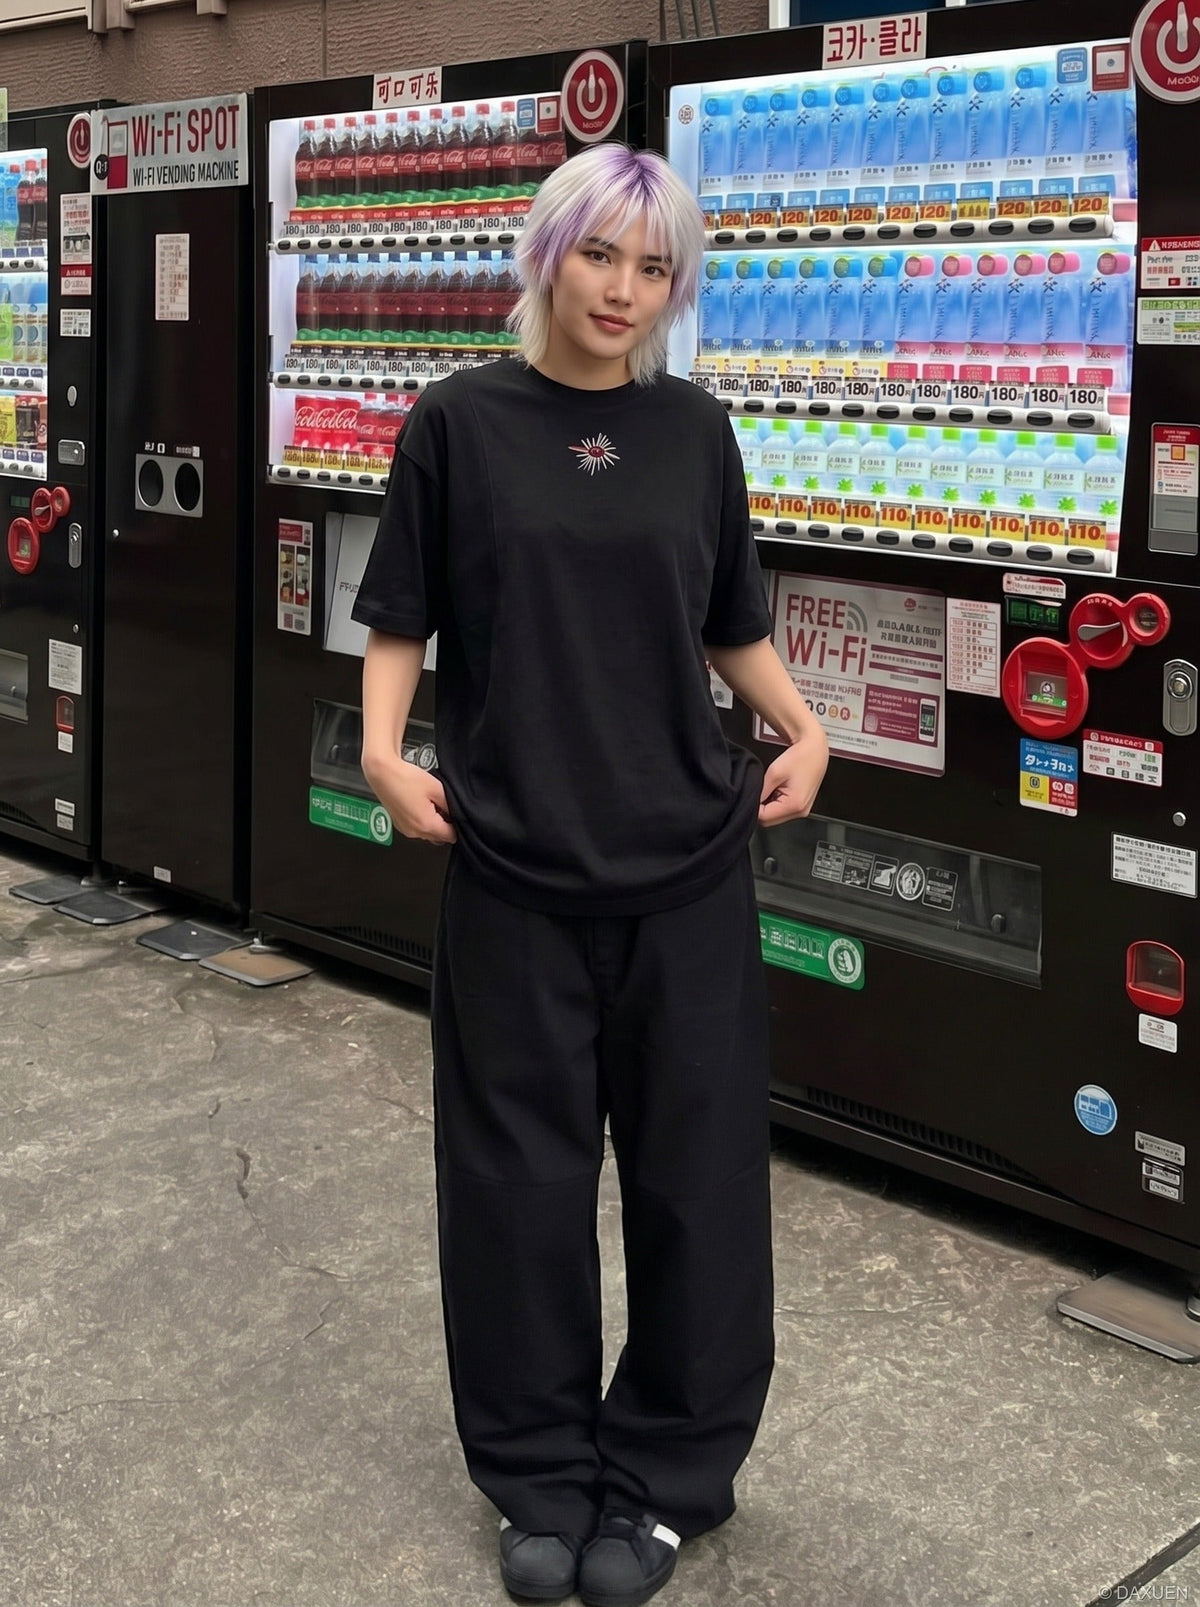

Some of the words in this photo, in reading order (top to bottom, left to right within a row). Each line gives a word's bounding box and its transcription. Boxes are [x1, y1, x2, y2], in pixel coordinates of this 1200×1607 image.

[376, 71, 438, 104] 可口可乐
[132, 111, 181, 157] Wi-Fi
[187, 104, 240, 153] SPOT
[133, 167, 155, 187] WI-FI
[157, 163, 196, 185] VENDING
[998, 202, 1025, 215] 120
[1034, 200, 1062, 214] 120
[1072, 197, 1103, 212] 120
[782, 211, 804, 224] 120
[814, 210, 838, 223] 120
[848, 208, 872, 221] 120
[885, 207, 911, 220] 120
[920, 205, 945, 219] 120
[720, 214, 742, 226] 120
[750, 213, 772, 226] 120
[786, 593, 846, 630] FREE
[786, 625, 868, 676] Wi-Fi
